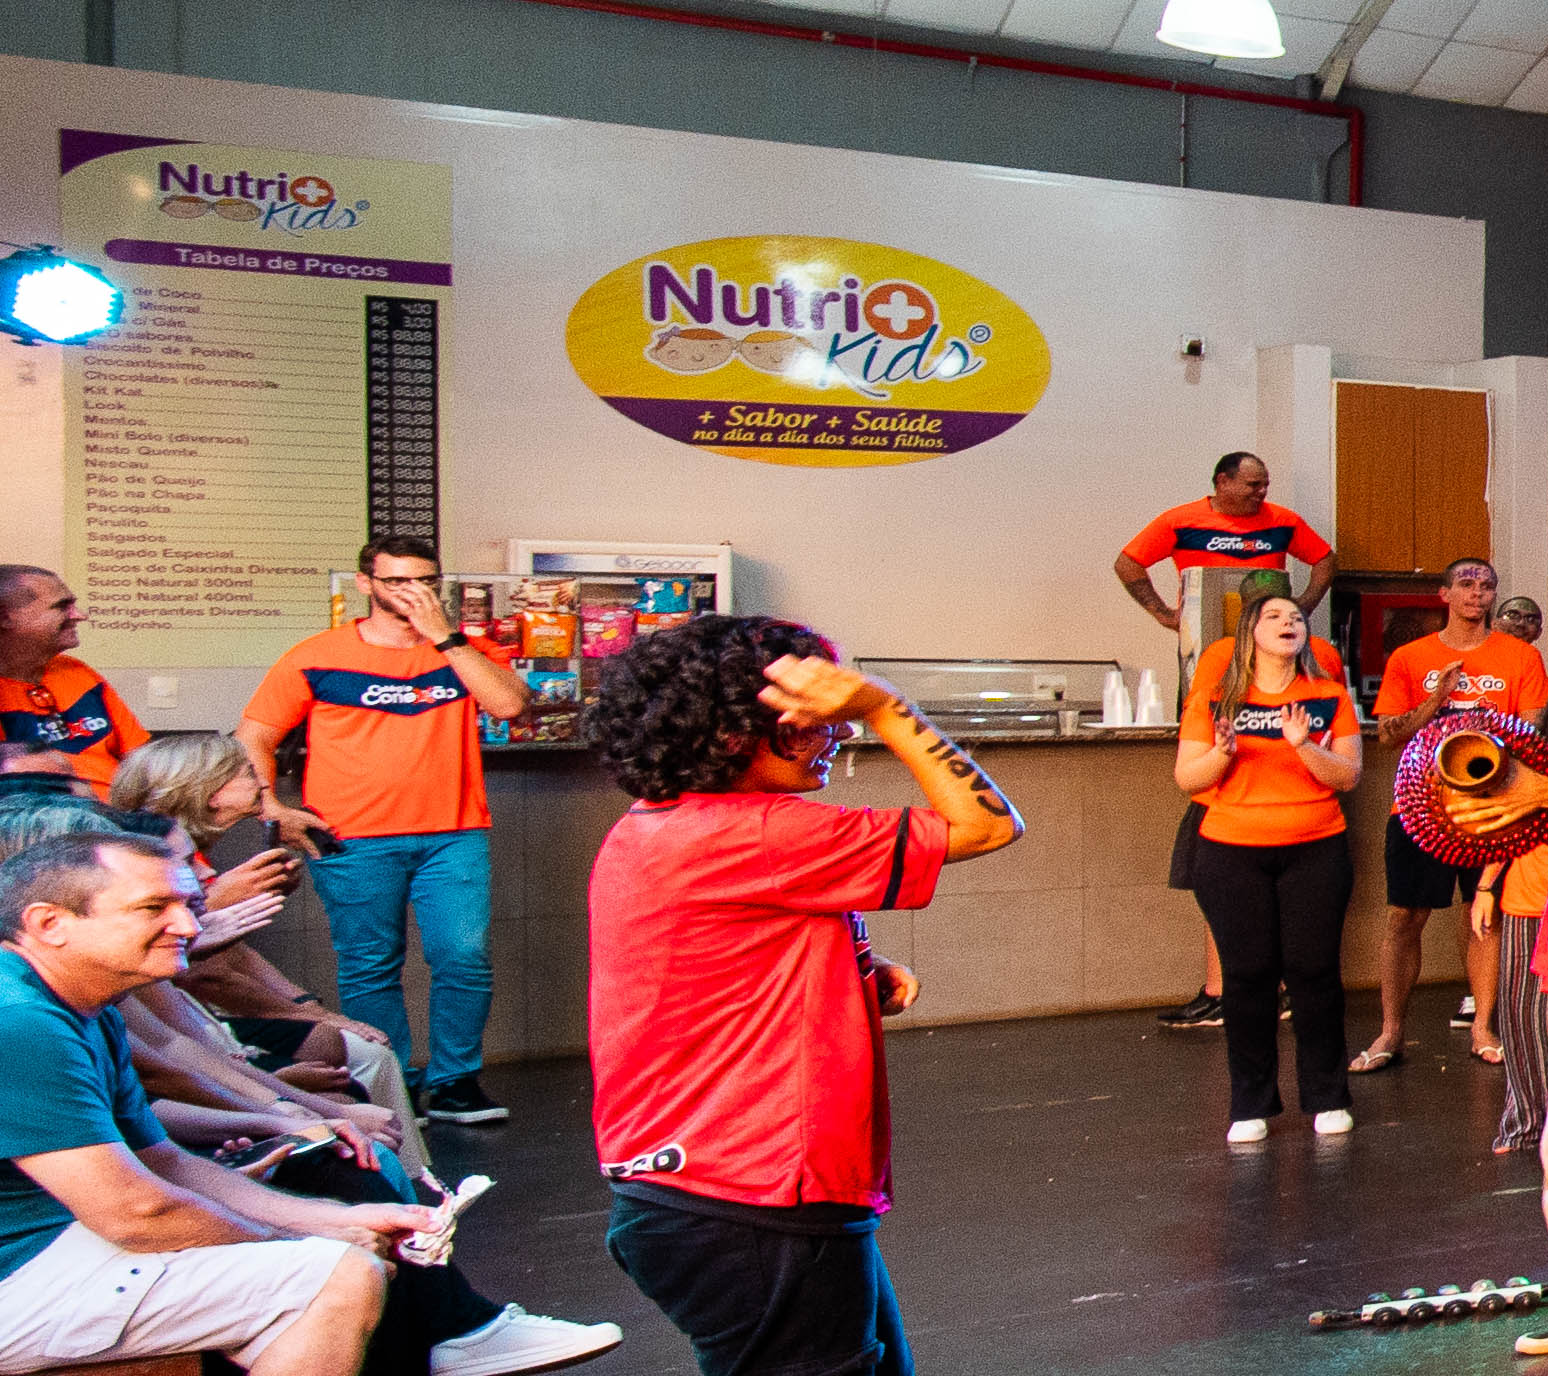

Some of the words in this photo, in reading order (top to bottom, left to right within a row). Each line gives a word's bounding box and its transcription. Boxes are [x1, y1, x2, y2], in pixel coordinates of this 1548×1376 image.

[158, 160, 291, 205] Nutri
[175, 247, 260, 271] Tabela
[268, 253, 298, 272] de
[305, 257, 390, 282] Preços
[648, 264, 860, 334] Nutri
[815, 324, 983, 399] Kids
[725, 405, 817, 430] Sabor
[854, 410, 942, 434] Saúde
[693, 430, 718, 442] no
[723, 428, 756, 444] dia
[760, 432, 774, 444] a
[778, 430, 810, 446] dia
[814, 430, 845, 446] dos
[851, 436, 888, 448] seus
[892, 432, 949, 451] filhos.
[87, 547, 158, 559] Salgado
[87, 562, 146, 574] Sucos
[150, 564, 167, 574] de
[250, 565, 318, 575] Diversos
[88, 577, 132, 588] Suco
[137, 577, 199, 588] Natural
[88, 591, 132, 602] Suco
[137, 592, 199, 602] Natural
[88, 606, 205, 618] Refrigerantes
[209, 607, 282, 617] Diversos
